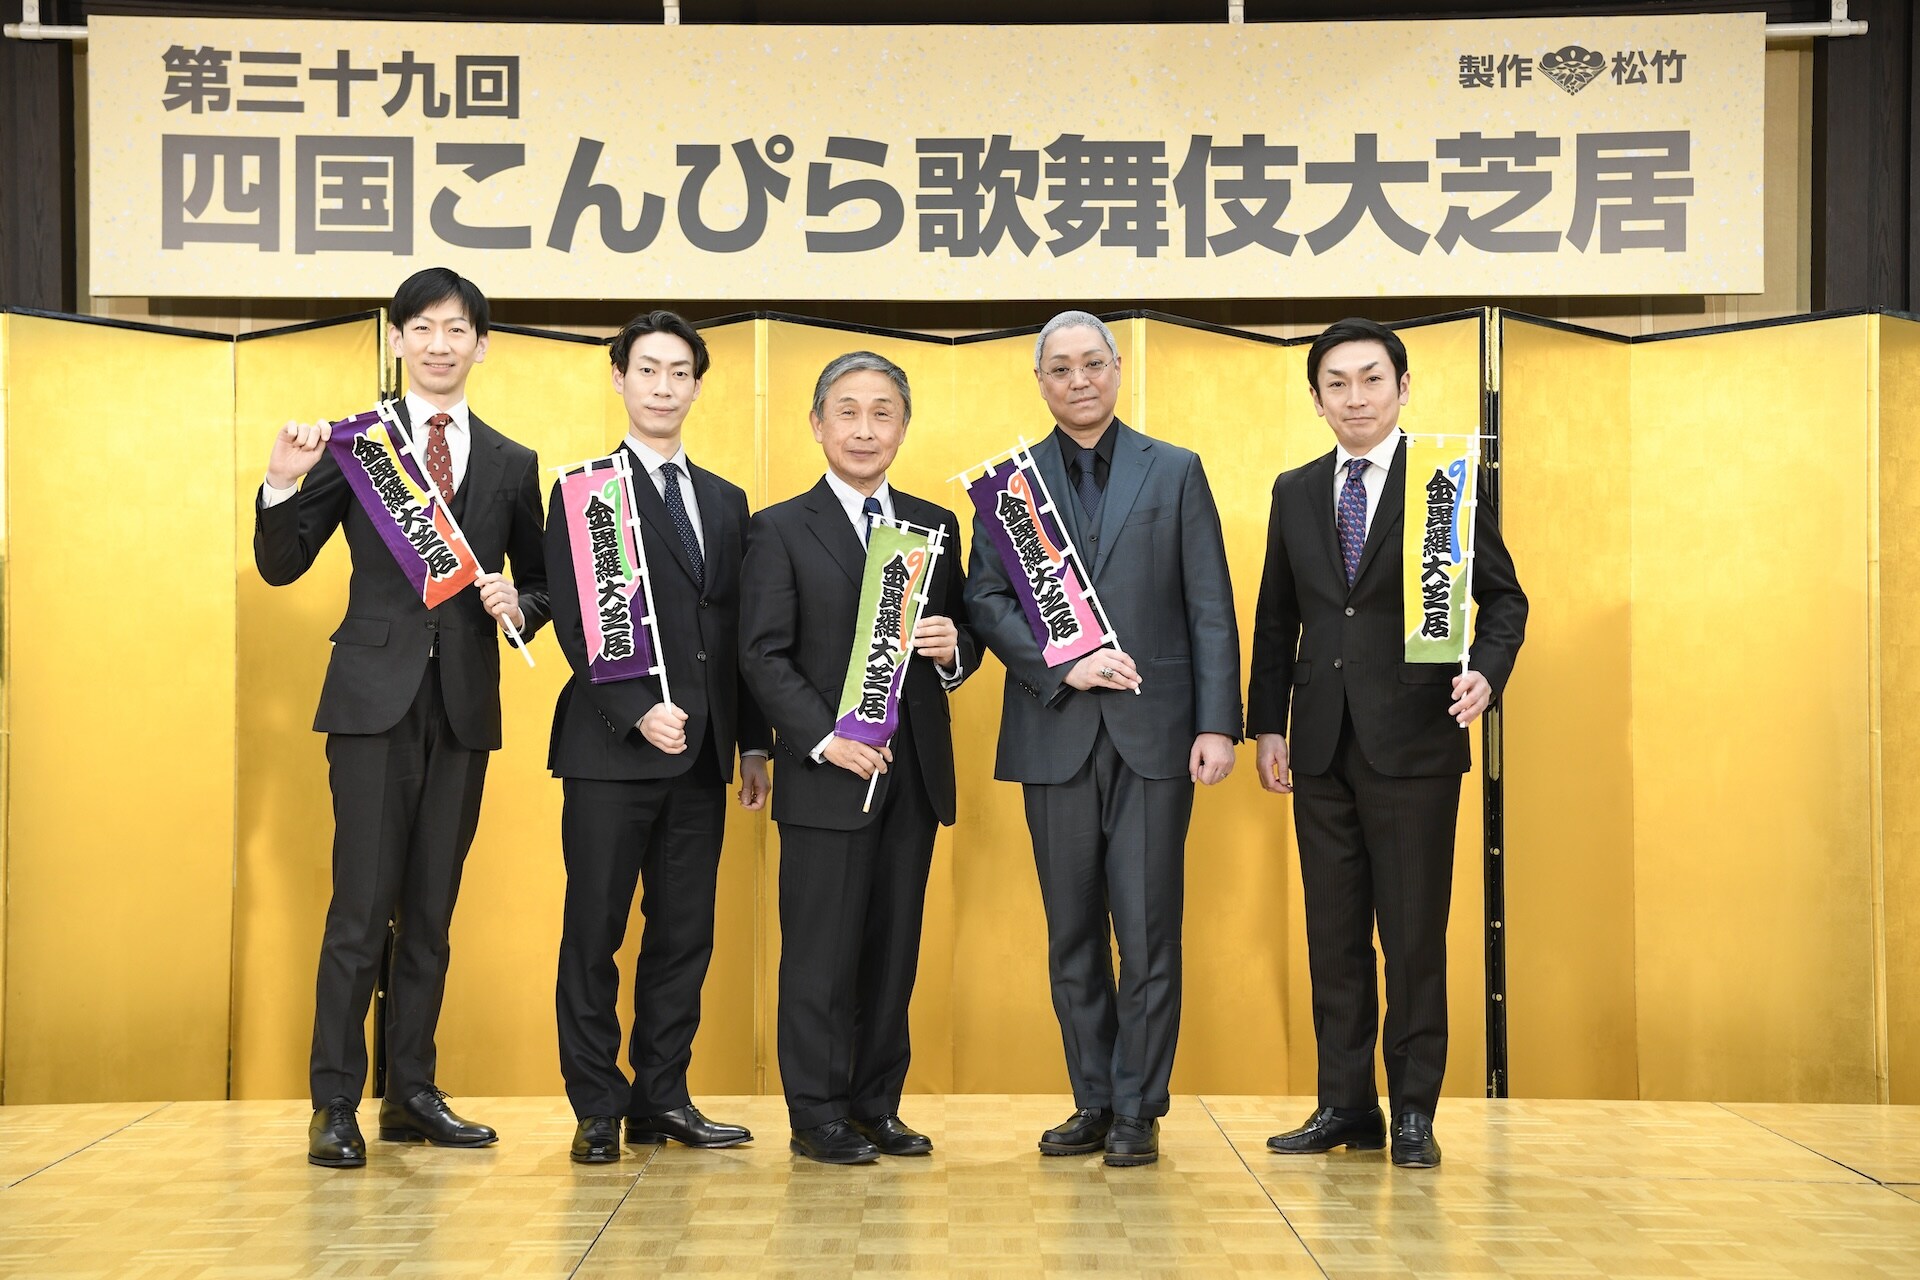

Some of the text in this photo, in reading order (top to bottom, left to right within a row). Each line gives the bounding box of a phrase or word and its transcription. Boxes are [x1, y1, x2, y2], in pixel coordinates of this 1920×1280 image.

[161, 45, 520, 120] 第三十九回
[1457, 50, 1687, 89] 製作 松竹
[161, 130, 1695, 258] 四国こんぴら歌舞伎大芝居
